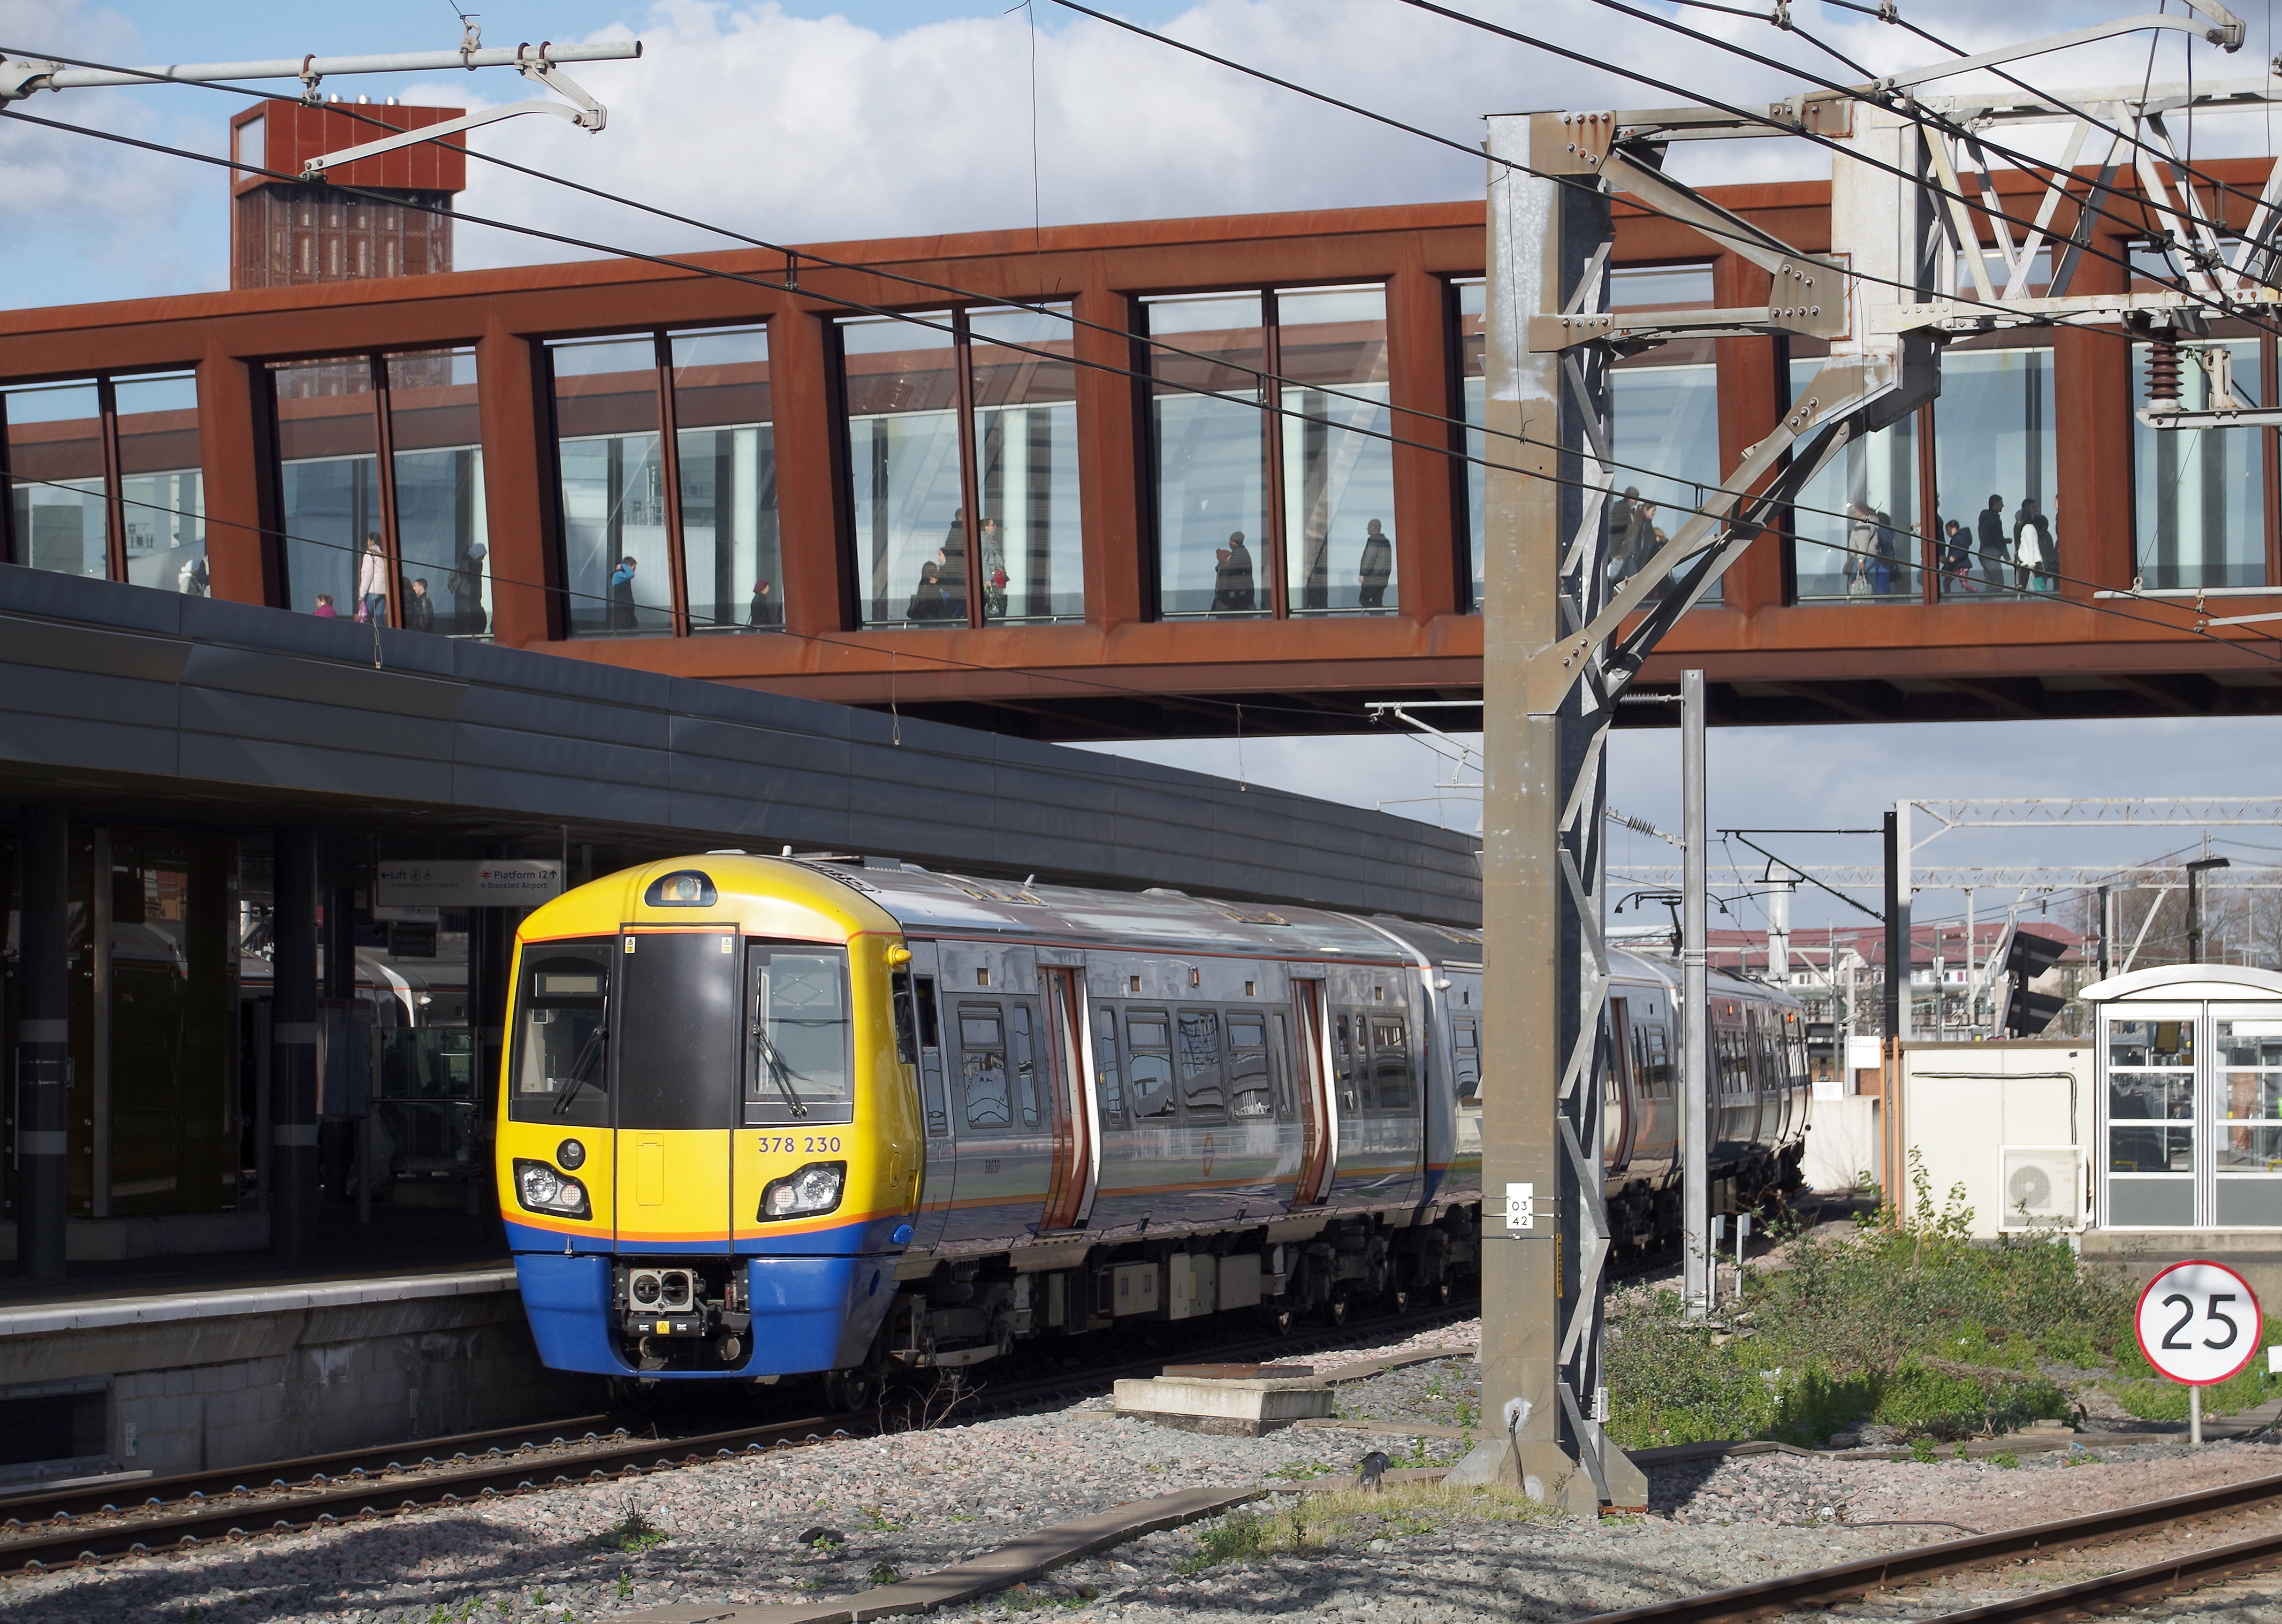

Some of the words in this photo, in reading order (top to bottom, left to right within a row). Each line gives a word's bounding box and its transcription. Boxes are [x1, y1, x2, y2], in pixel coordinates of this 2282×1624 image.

[391, 871, 407, 879] Lift
[495, 871, 536, 879] Platform
[539, 871, 547, 879] 12
[758, 1137, 795, 1153] 378
[804, 1137, 841, 1153] 230
[984, 1159, 1000, 1175] 38030
[1512, 1201, 1527, 1210] 03
[1512, 1216, 1527, 1225] 42
[2162, 1294, 2237, 1349] 25
